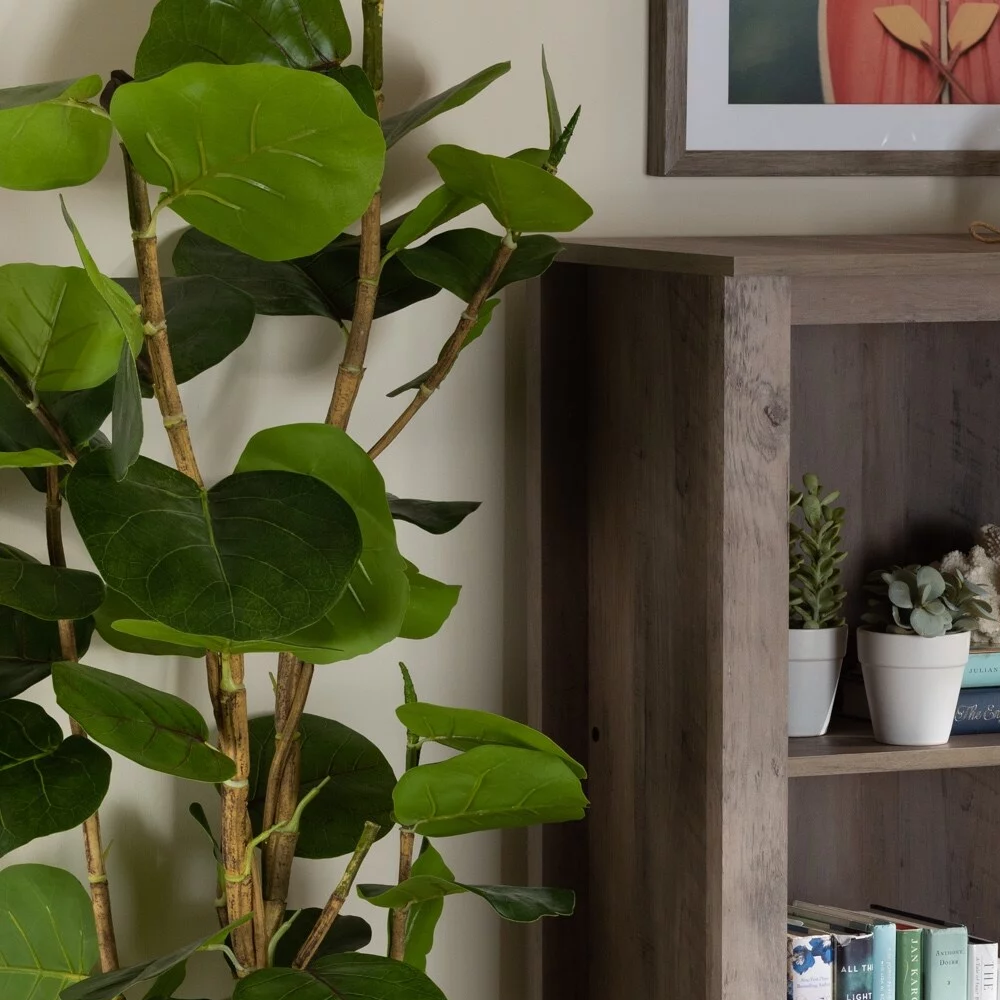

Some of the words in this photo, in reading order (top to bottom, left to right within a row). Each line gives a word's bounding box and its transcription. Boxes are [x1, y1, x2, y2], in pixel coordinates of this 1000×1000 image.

[969, 665, 1000, 674] JULIAN
[955, 704, 982, 722] The
[910, 938, 919, 962] JAN
[840, 965, 859, 973] ALL
[861, 963, 874, 972] TH
[983, 964, 994, 990] THE
[846, 992, 873, 1000] LIGHT
